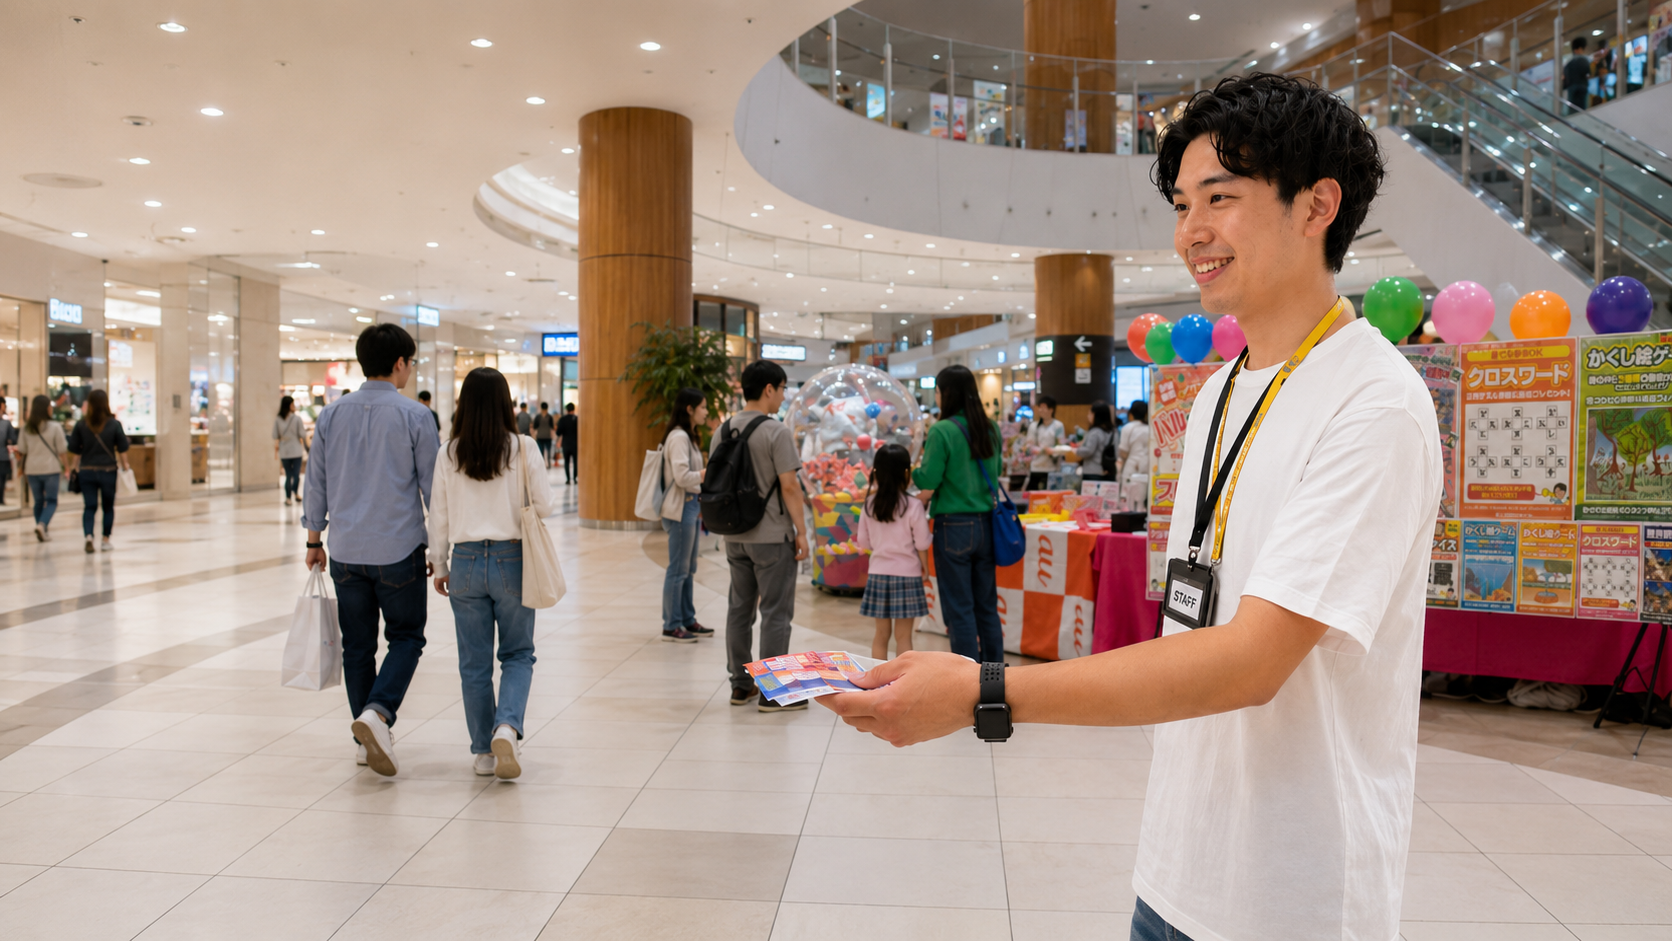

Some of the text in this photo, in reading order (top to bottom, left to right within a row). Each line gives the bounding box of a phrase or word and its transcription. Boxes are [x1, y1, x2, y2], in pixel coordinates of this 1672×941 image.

[1468, 363, 1569, 388] クロスワード
[1582, 535, 1637, 548] クロスワード
[1038, 534, 1053, 588] au
[1173, 590, 1197, 609] STAFF
